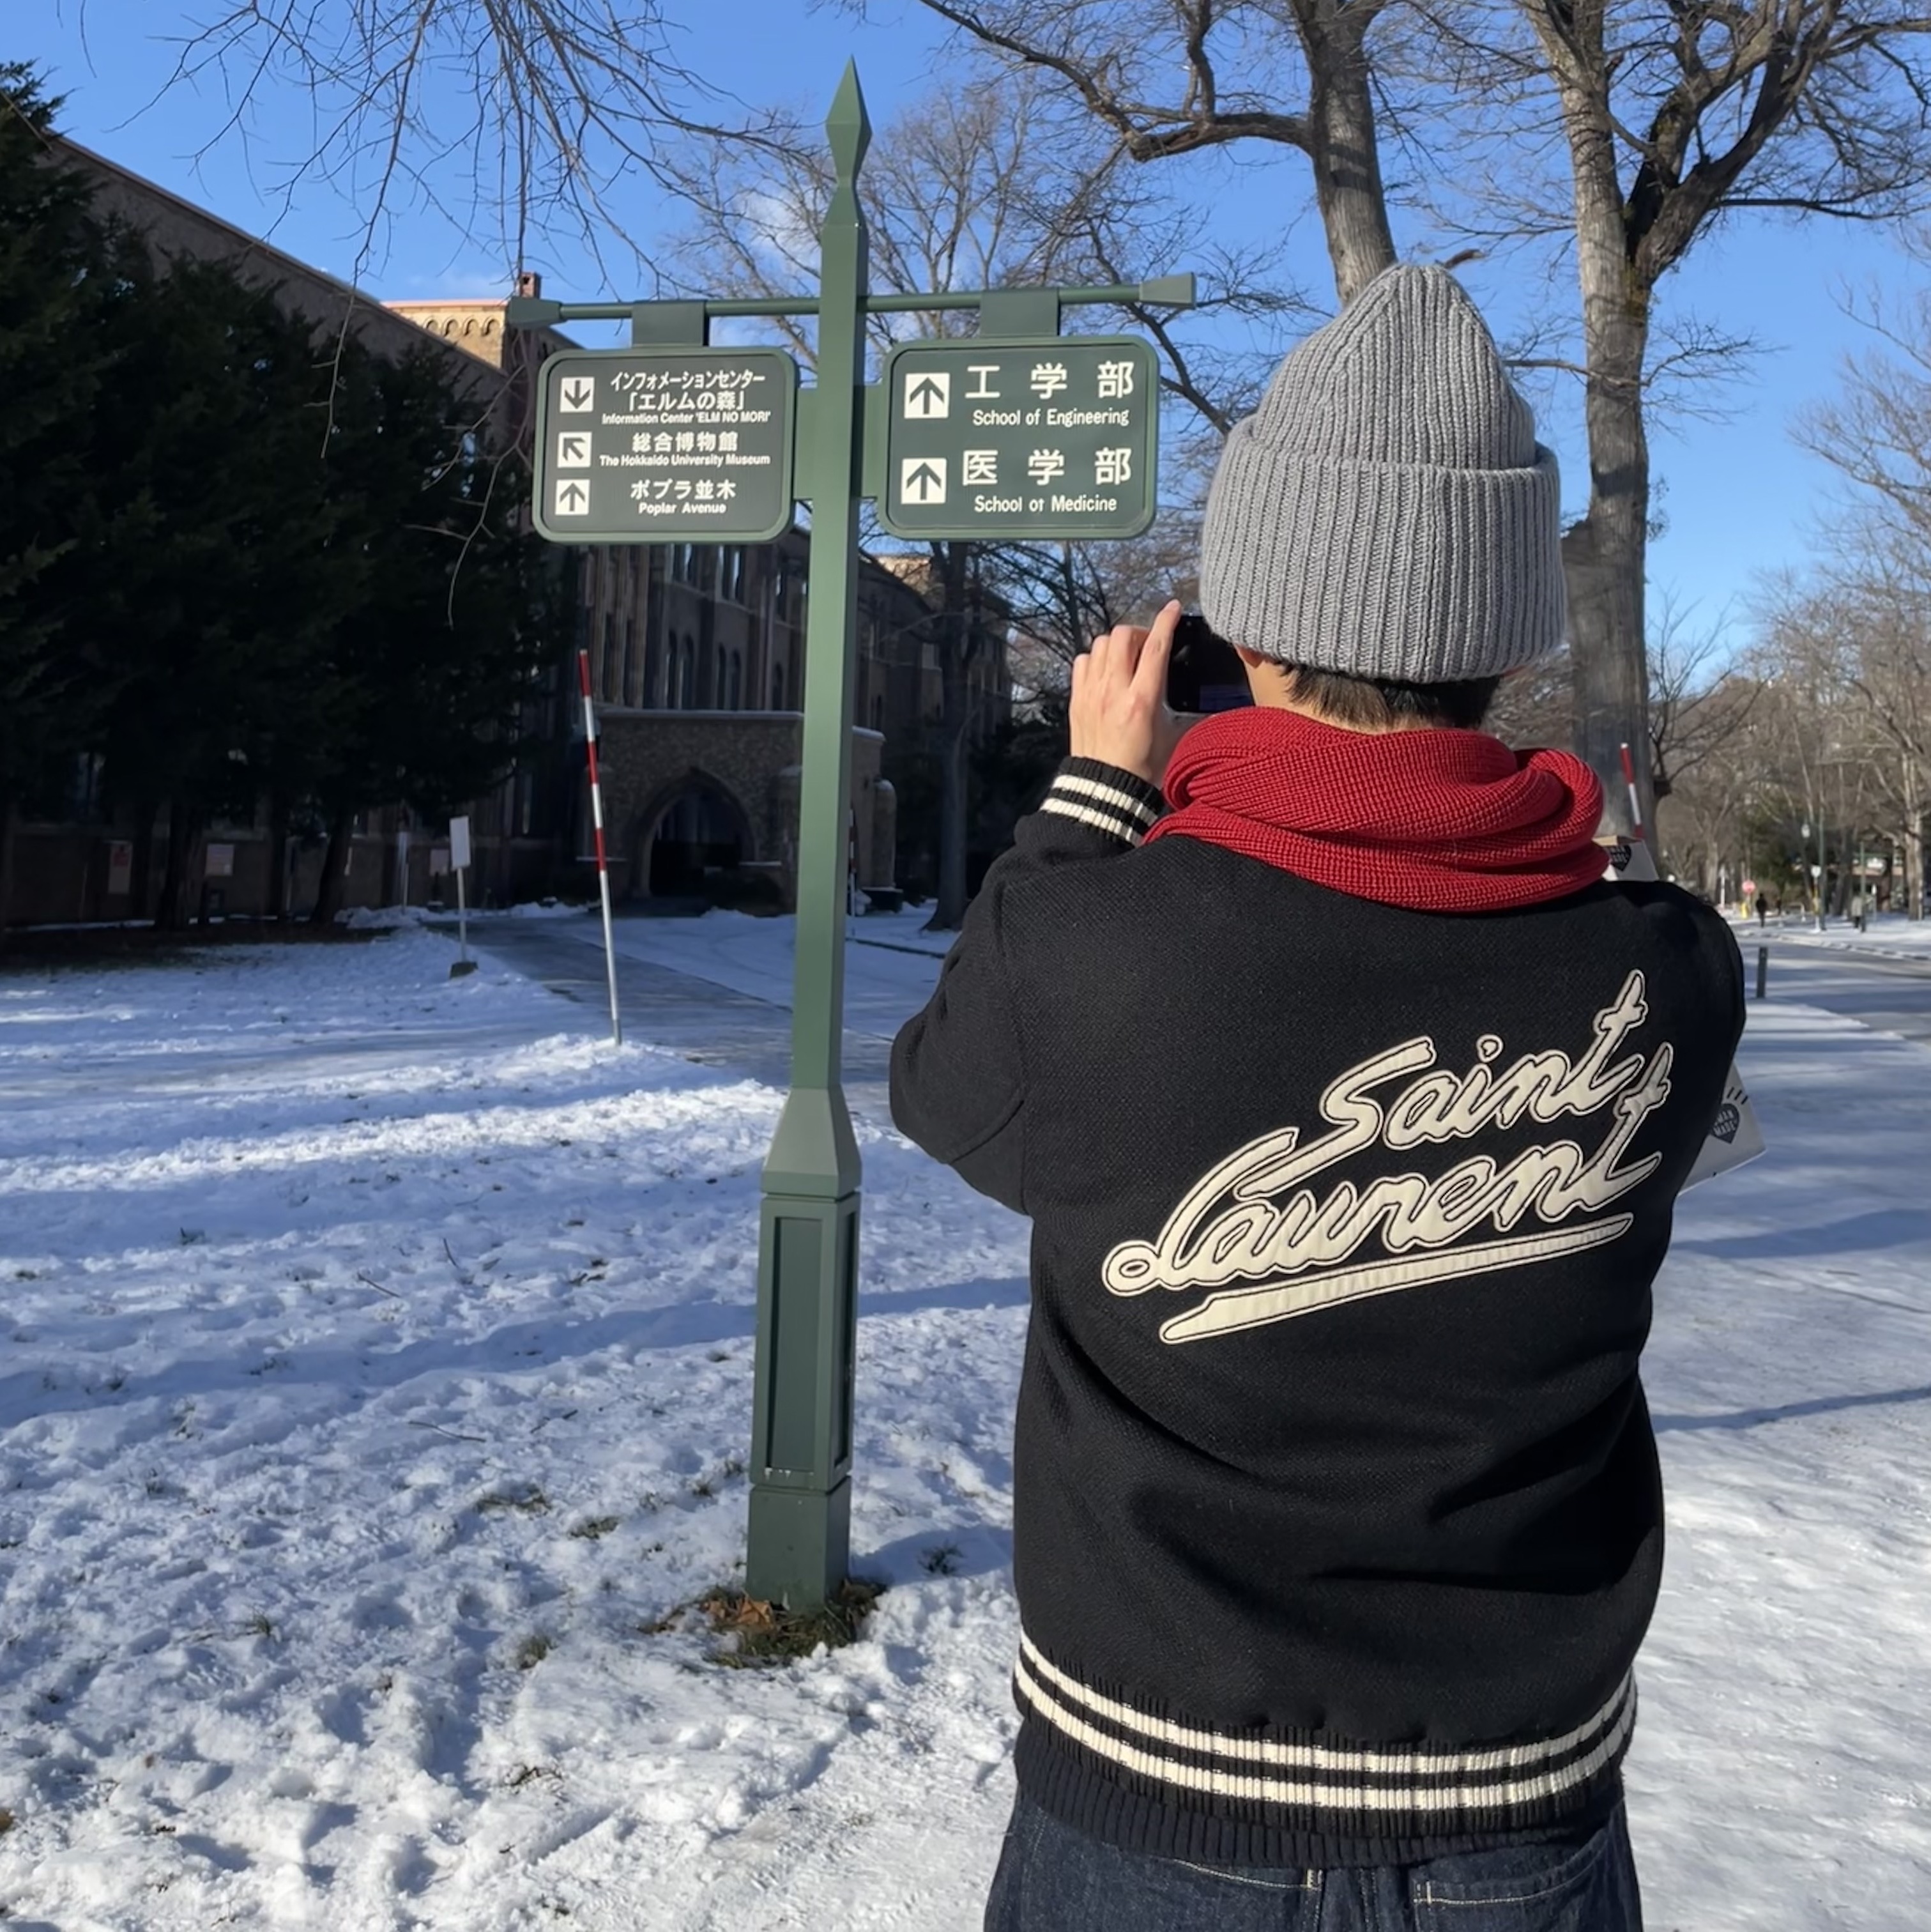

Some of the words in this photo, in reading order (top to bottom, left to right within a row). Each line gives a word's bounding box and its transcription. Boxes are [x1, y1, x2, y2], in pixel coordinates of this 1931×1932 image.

[611, 369, 765, 391] インフォメーションセンター
[965, 360, 1134, 399] 工学部
[629, 390, 744, 411] 「エルムの森」
[602, 412, 659, 424] Information
[660, 411, 694, 424] Center
[722, 411, 739, 423] NO
[973, 409, 1021, 426] School
[1025, 408, 1041, 425] of
[1047, 407, 1129, 428] Engineering
[632, 431, 738, 452] 総合博物館
[599, 454, 620, 466] The
[620, 454, 669, 466] Hokkaido
[671, 453, 724, 468] University
[725, 453, 771, 465] Museum
[962, 447, 1132, 486] 医学部
[630, 478, 737, 500] ポプラ並木
[639, 502, 677, 516] Poplar
[681, 502, 727, 514] Avenue
[974, 494, 1022, 512] School
[1051, 494, 1117, 512] Medicine
[1238, 969, 1649, 1196] Saint
[1102, 1042, 1674, 1296] Laurent
